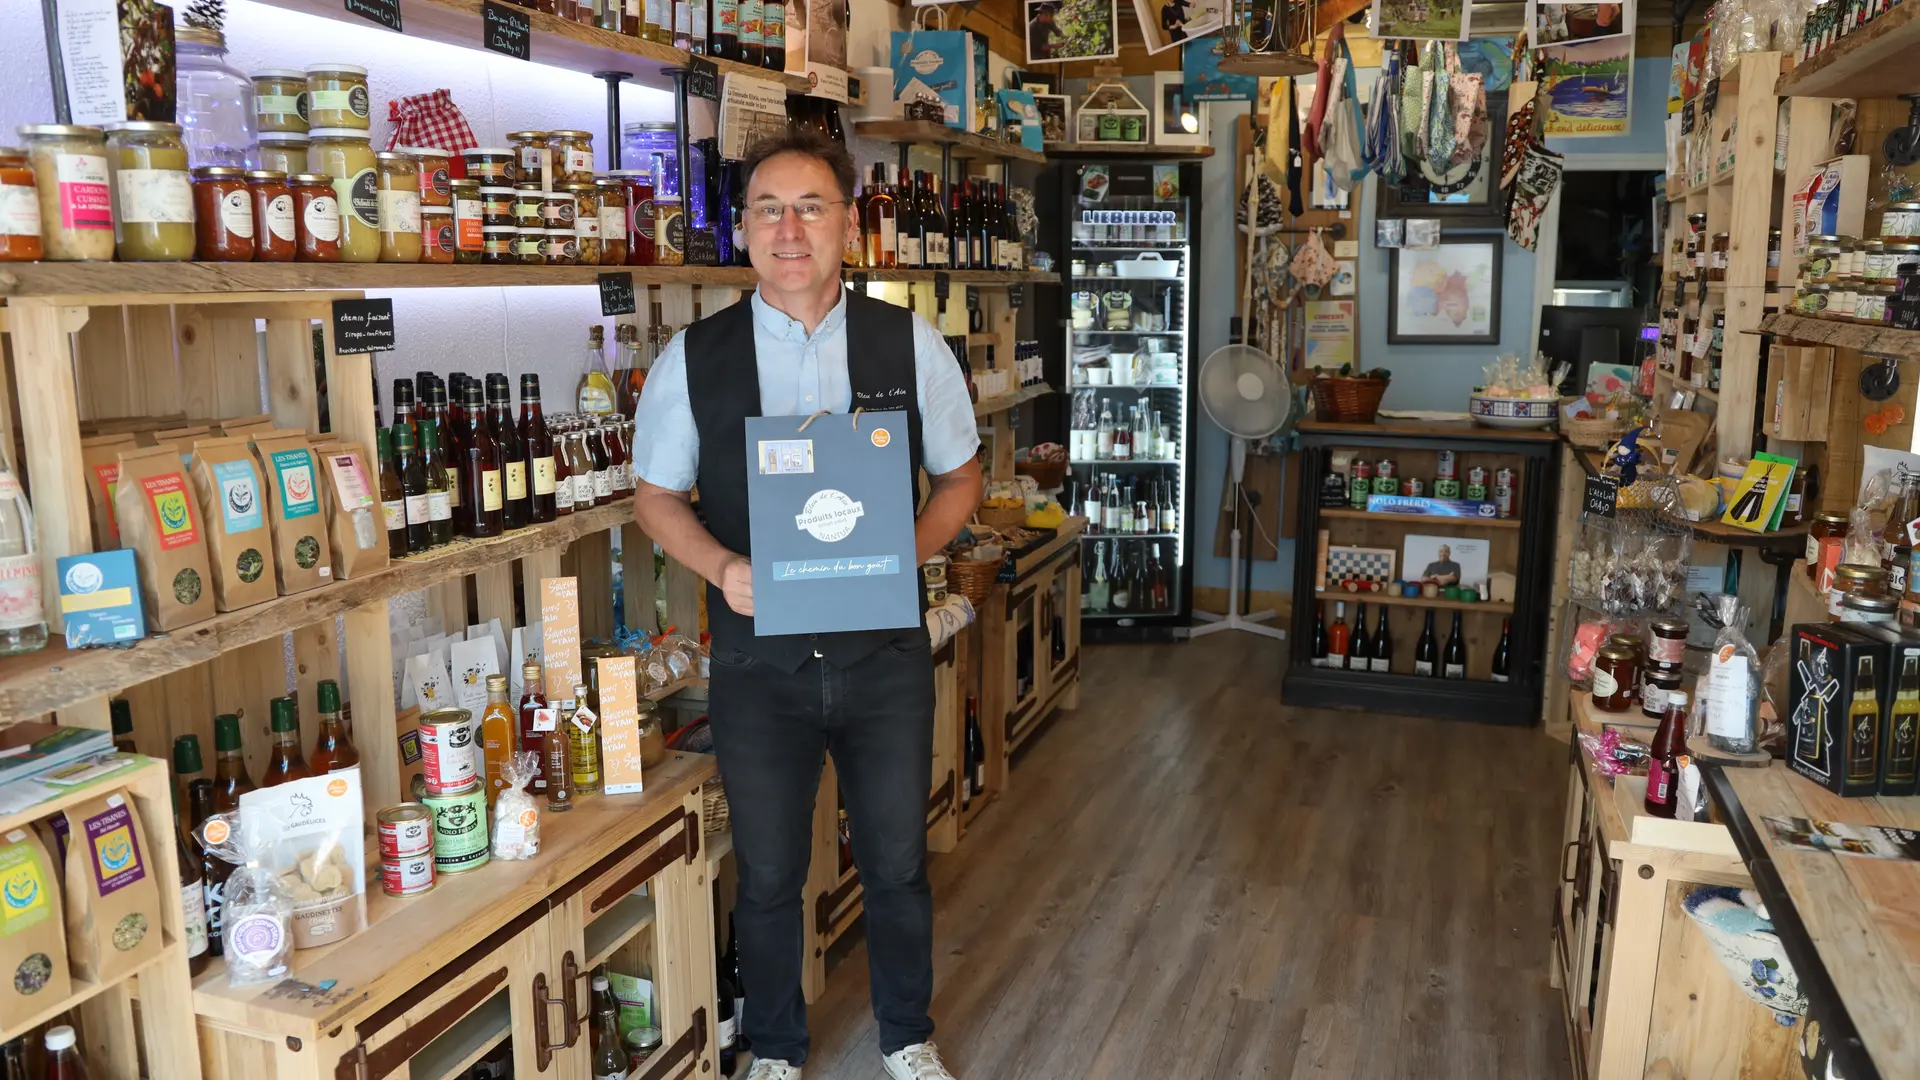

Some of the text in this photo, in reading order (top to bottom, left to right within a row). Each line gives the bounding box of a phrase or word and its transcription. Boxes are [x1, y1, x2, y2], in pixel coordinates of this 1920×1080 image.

[1083, 211, 1176, 225] LIEBHERR
[798, 506, 861, 526] Produits locaux
[781, 556, 893, 577] Le chemin du bon goût
